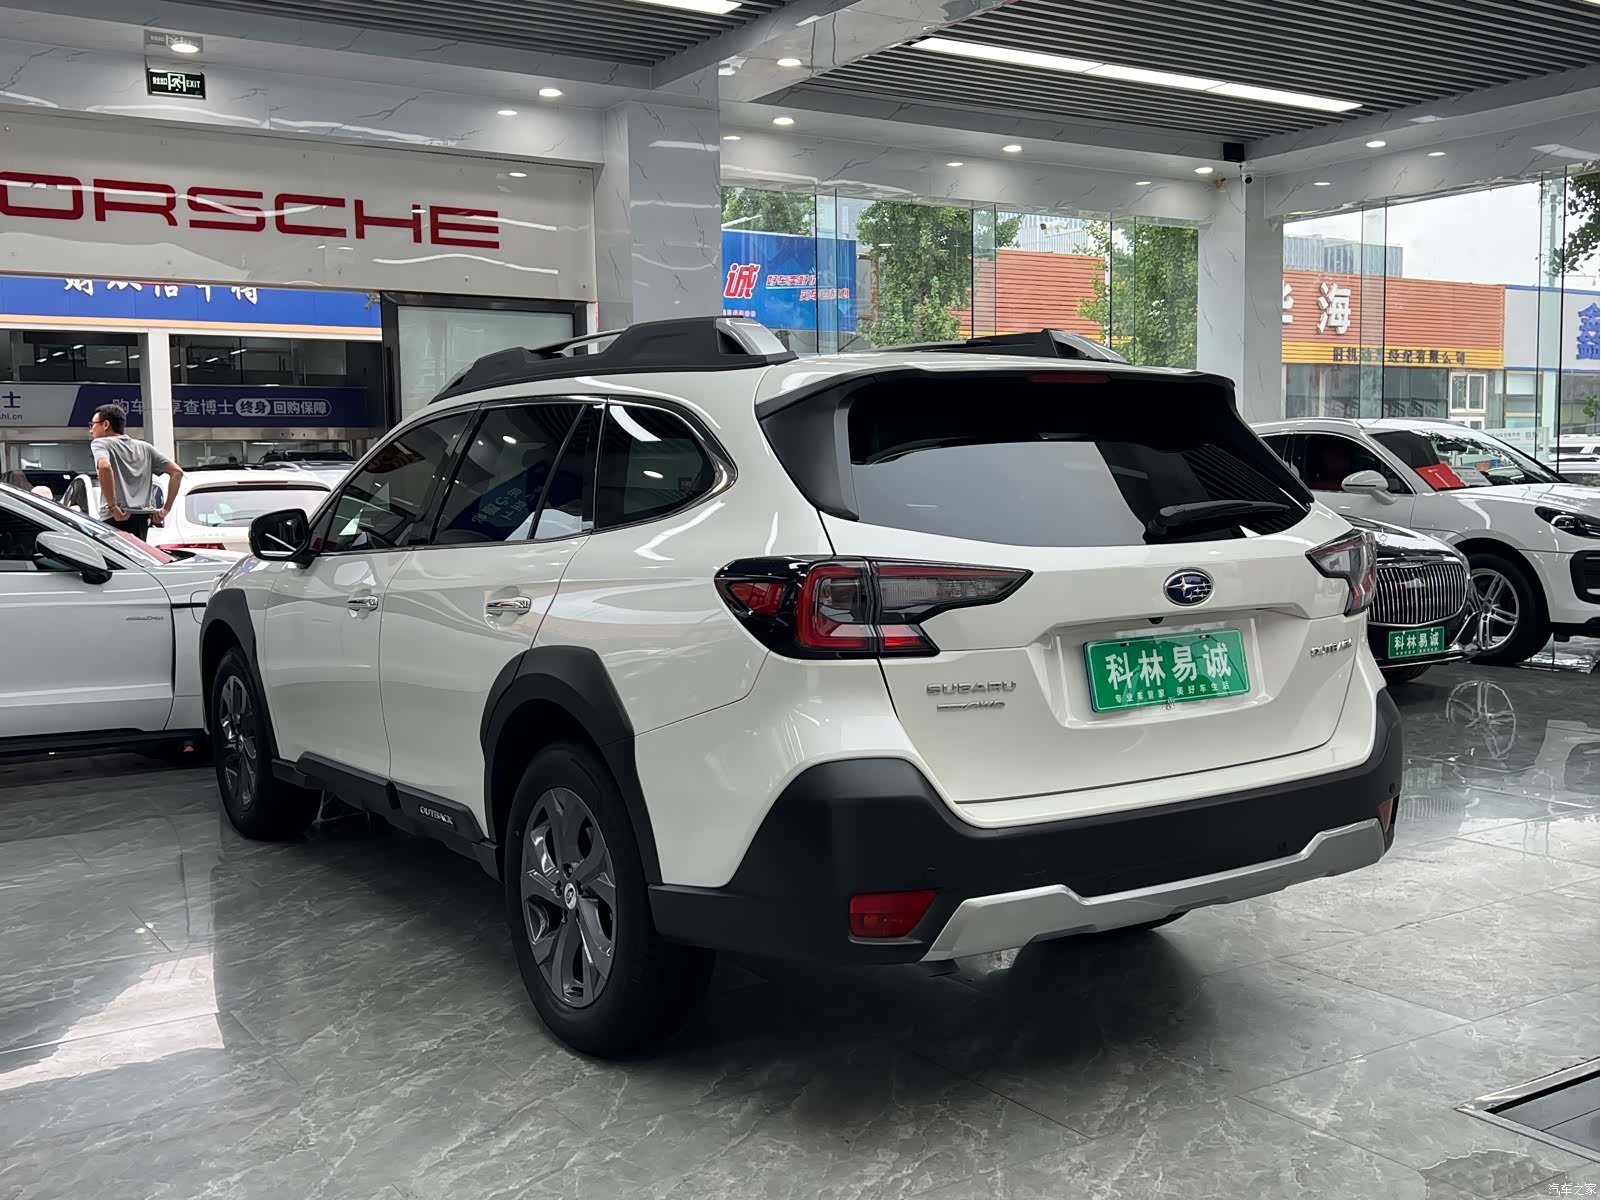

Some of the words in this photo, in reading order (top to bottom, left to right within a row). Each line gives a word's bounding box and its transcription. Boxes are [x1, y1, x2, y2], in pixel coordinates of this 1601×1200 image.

[186, 79, 201, 89] EXIT
[723, 263, 761, 299] 诚
[240, 400, 267, 414] 终身
[273, 400, 327, 415] 回购保障
[1393, 631, 1440, 651] 科林易诚
[1104, 641, 1232, 691] 科林易诚
[926, 681, 1016, 694] SUBARU
[1176, 680, 1230, 696] 美好车生活
[419, 805, 454, 825] OUTBACK
